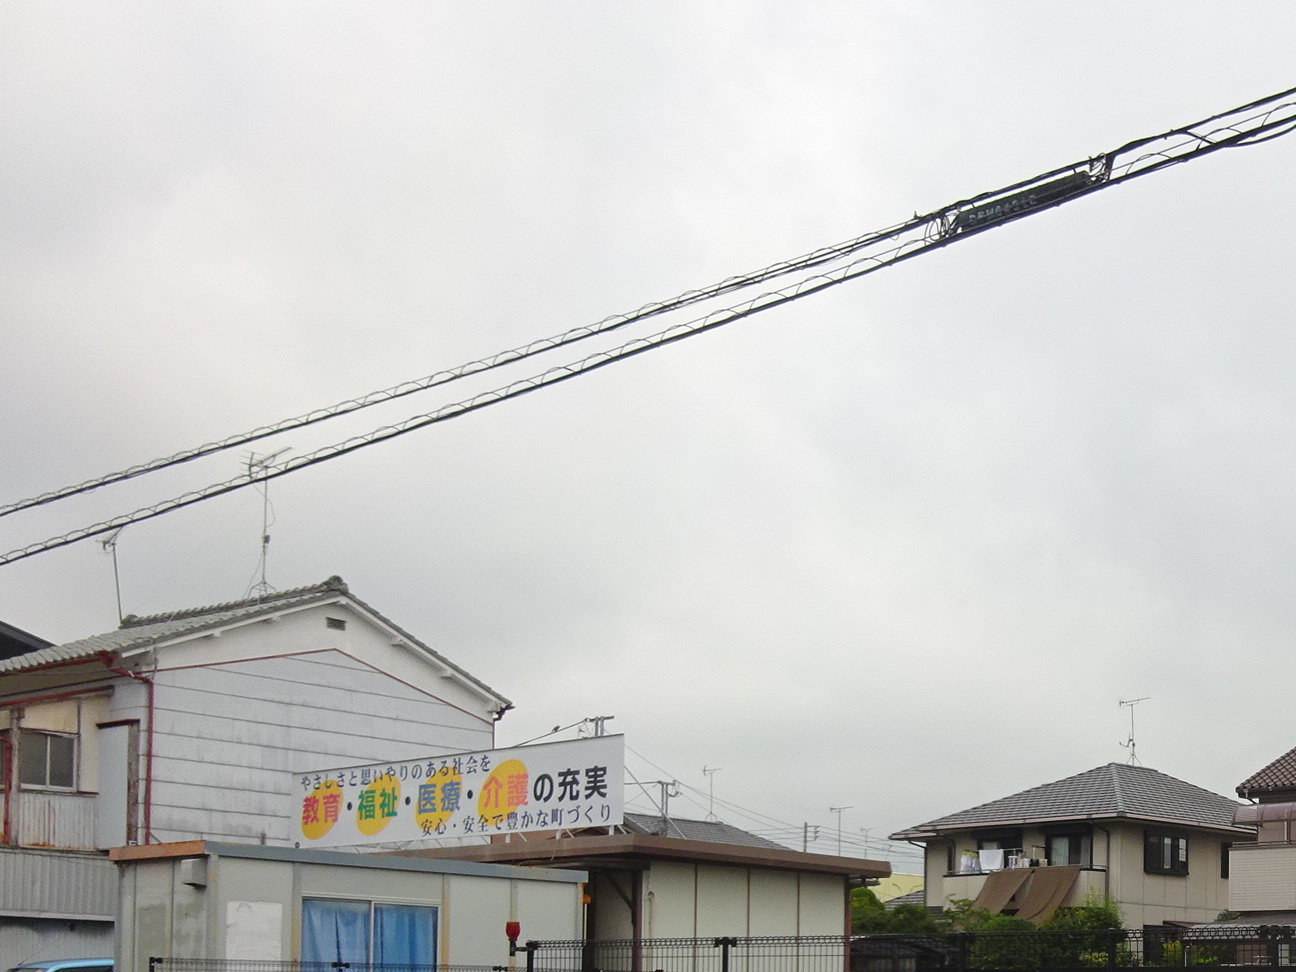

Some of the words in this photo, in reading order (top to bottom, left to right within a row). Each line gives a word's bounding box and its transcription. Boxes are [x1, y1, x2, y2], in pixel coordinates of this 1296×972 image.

[301, 755, 491, 791] やさしさと思いやりのある社会を
[302, 766, 607, 825] 教育・福祉・医療・介護の充実
[421, 804, 611, 837] 安心・安全で豊かな町づくり
